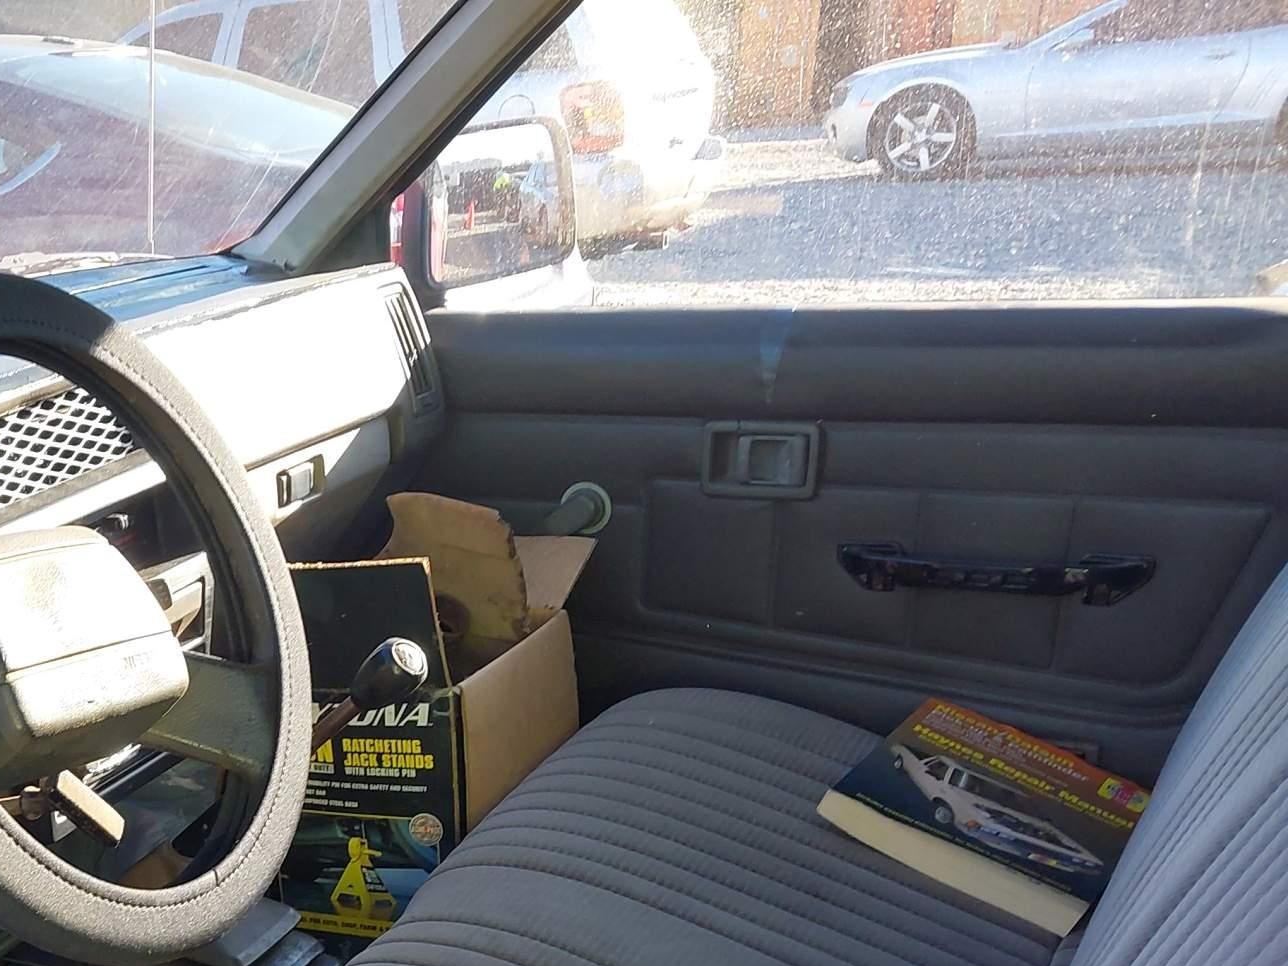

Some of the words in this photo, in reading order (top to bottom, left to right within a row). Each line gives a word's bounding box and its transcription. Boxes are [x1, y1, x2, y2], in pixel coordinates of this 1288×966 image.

[341, 737, 422, 754] RATCHETING
[343, 753, 378, 767] JACK
[381, 754, 434, 769] STANDS
[344, 766, 365, 777] WITH
[367, 767, 401, 778] LOCKING
[402, 768, 417, 778] PIN
[912, 723, 985, 760] Haynes
[988, 757, 1055, 792] Repair
[1057, 789, 1134, 829] Manual
[369, 783, 389, 791] SAFETY
